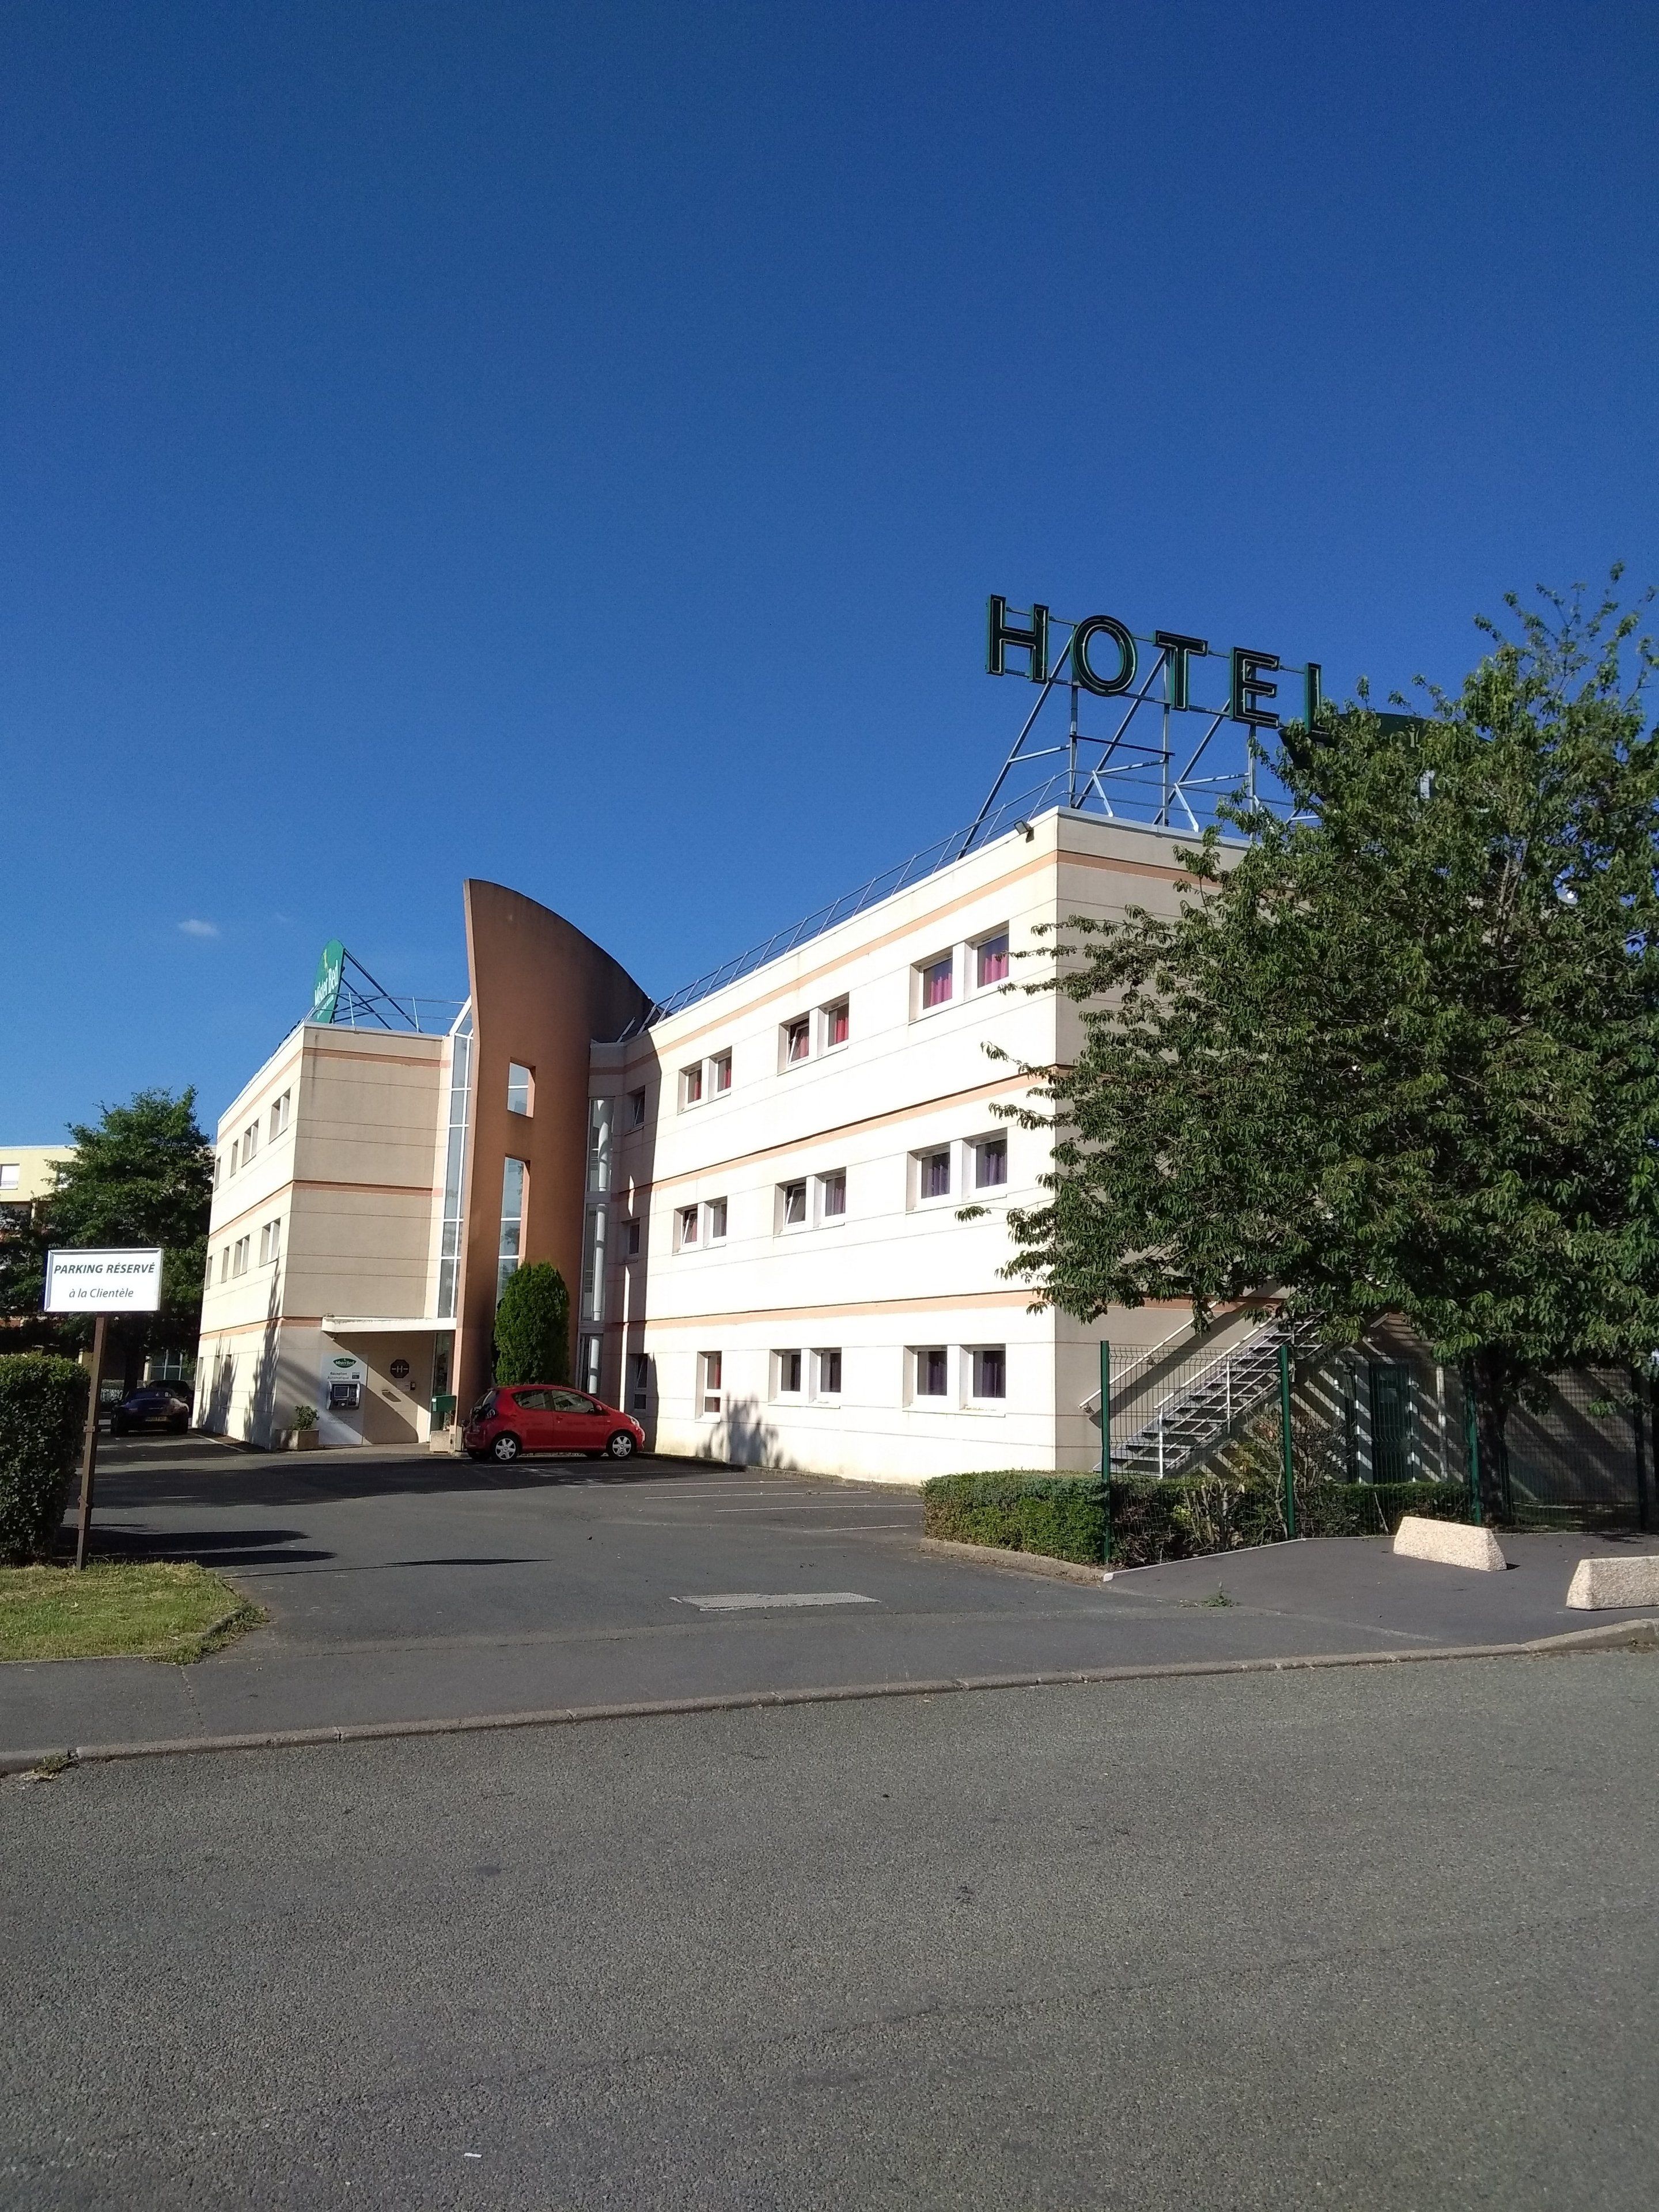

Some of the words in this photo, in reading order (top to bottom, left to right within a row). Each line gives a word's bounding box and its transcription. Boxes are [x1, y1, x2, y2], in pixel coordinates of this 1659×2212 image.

[986, 593, 1330, 739] HOTEL
[315, 978, 328, 1006] Mister
[328, 959, 338, 994] Bed
[54, 1264, 103, 1274] PARKING
[106, 1262, 156, 1274] RÉSERVÉ
[69, 1289, 75, 1298] à
[78, 1289, 87, 1298] la
[90, 1288, 134, 1298] Clientèle
